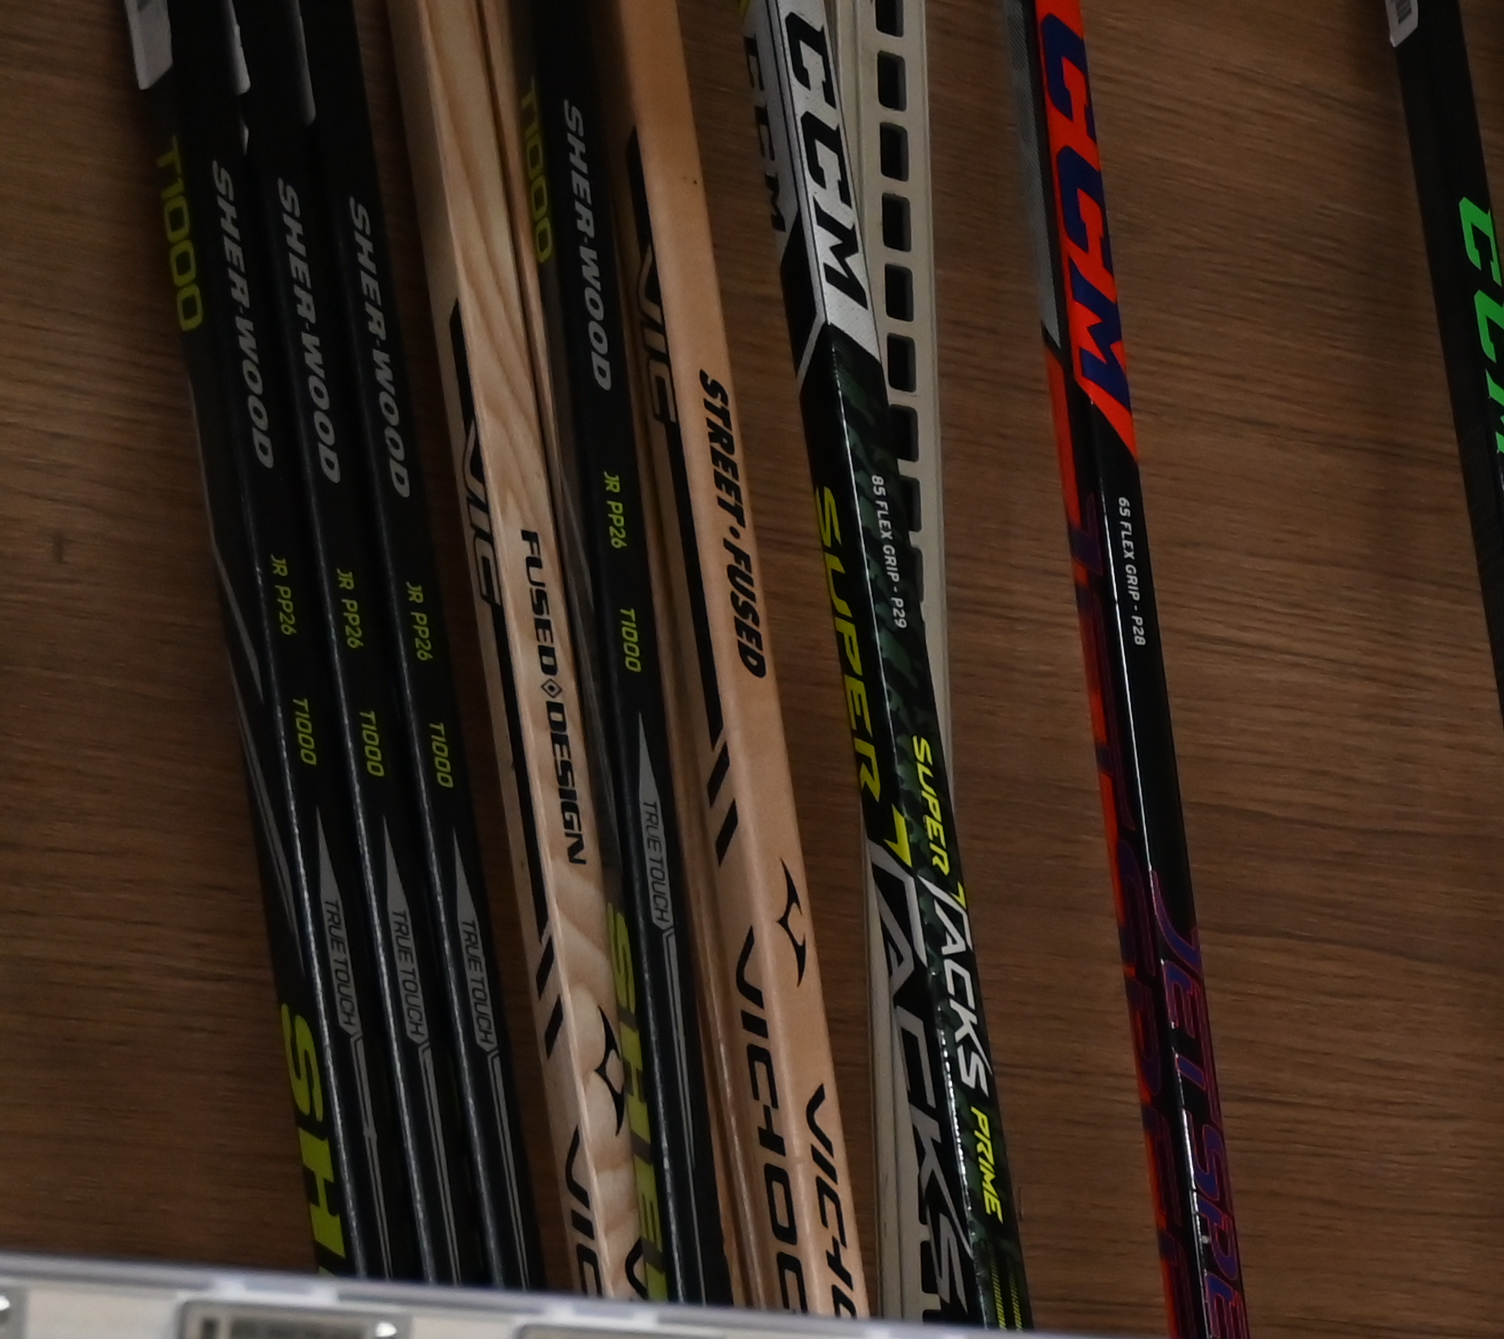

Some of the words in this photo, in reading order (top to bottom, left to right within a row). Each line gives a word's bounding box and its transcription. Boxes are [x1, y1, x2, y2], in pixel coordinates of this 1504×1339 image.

[784, 11, 869, 311] CCM
[157, 135, 203, 331] T1000
[564, 99, 611, 390] SHER-WOOD
[1041, 12, 1133, 415] CCM
[213, 160, 274, 469] SHER-WOOD
[278, 178, 341, 483] SHER-WOOD
[350, 196, 410, 497] SHER-WOOD
[604, 471, 620, 492] JR
[606, 501, 628, 549] PP26
[699, 369, 746, 531] STREET
[724, 538, 767, 678] FUSED
[872, 475, 884, 495] 85
[876, 498, 893, 539] FLEX
[1118, 497, 1131, 517] 65
[883, 544, 899, 583] GRIP
[1120, 521, 1135, 560] FLEX
[1125, 564, 1140, 601] GRIP
[620, 607, 641, 672] T1000
[815, 486, 882, 802] SUPER
[891, 597, 907, 628] P29
[1131, 615, 1146, 646] P28
[521, 529, 558, 676] FUSED
[546, 702, 587, 864] DESIGN
[642, 801, 662, 852] TRUE
[912, 735, 950, 877] SUPER
[648, 852, 671, 923] TOUCH
[917, 874, 993, 1097] TACKS
[970, 1107, 1003, 1224] PRIME
